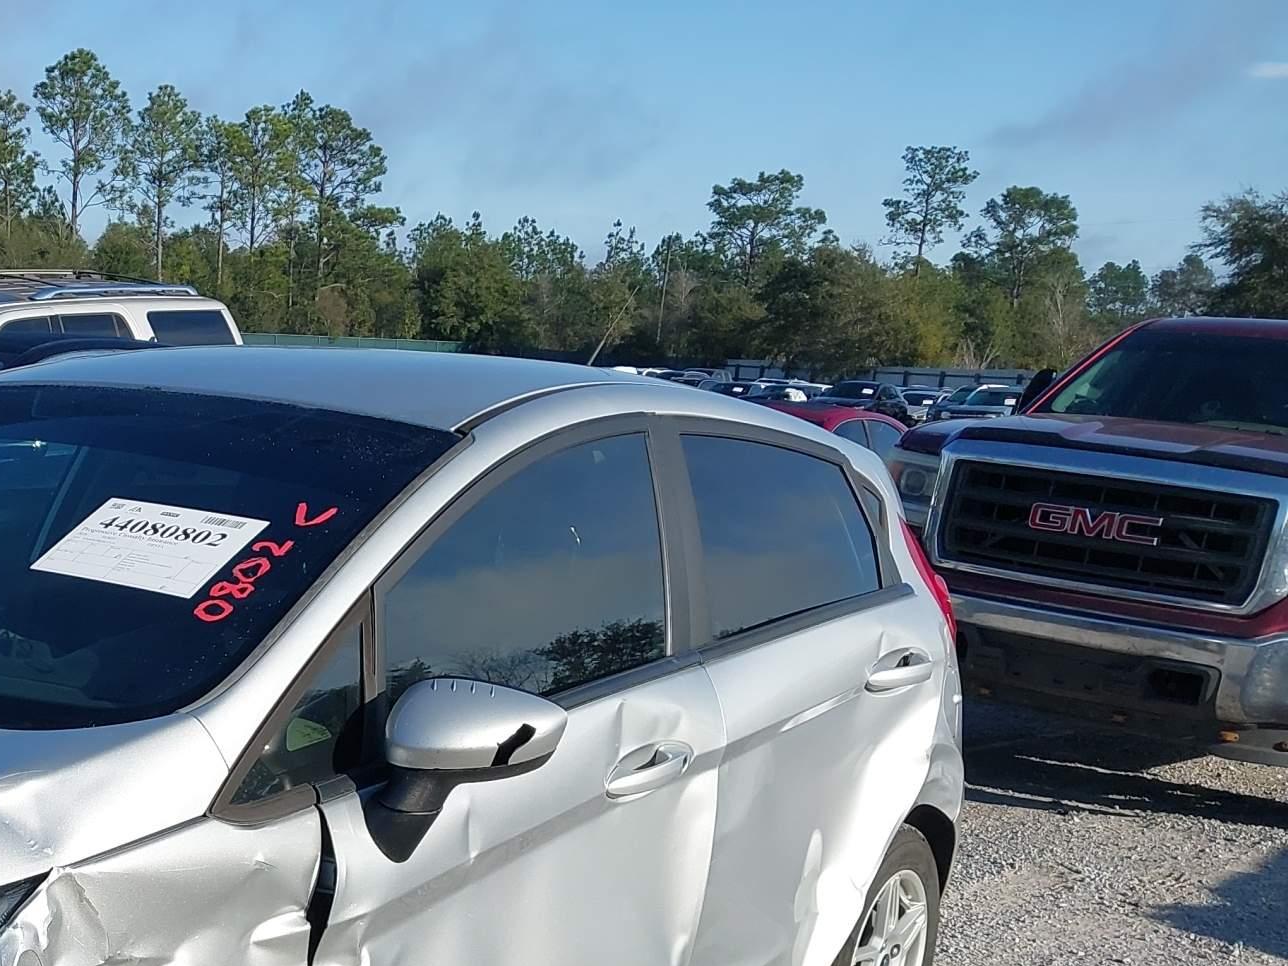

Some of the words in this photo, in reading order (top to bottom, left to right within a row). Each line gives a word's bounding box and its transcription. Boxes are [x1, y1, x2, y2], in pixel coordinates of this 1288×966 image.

[99, 515, 228, 547] 44080802
[1028, 502, 1164, 546] GMC
[193, 540, 295, 622] 0802
